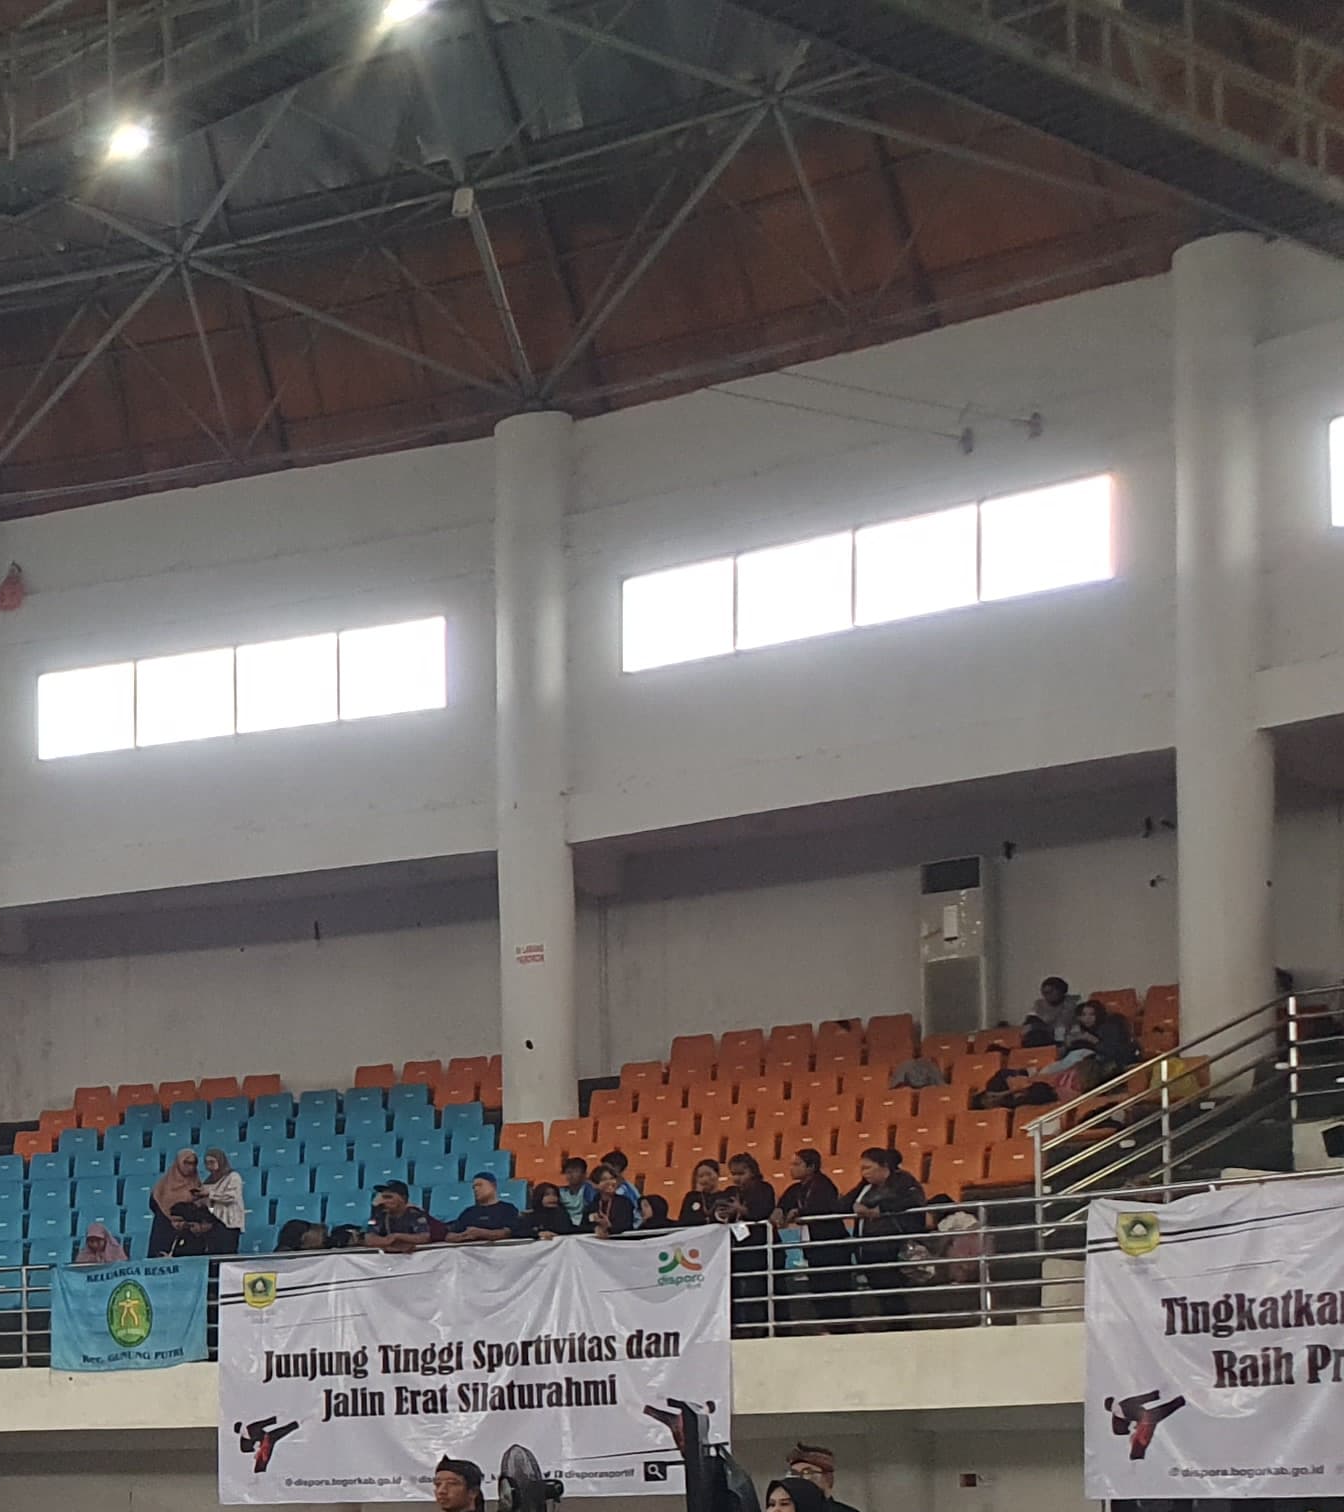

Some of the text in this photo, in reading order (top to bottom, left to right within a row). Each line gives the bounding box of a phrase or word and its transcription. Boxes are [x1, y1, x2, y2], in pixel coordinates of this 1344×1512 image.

[86, 1265, 180, 1283] KELUARGA BESAR
[1161, 1288, 1344, 1338] Tingkatka
[107, 1351, 151, 1363] GUNUNG
[154, 1348, 185, 1360] PUTRI
[263, 1329, 680, 1383] Junjung Tinggi Sportivitas dan
[1212, 1347, 1295, 1388] Raih
[322, 1374, 618, 1422] Jalin Erat Silaturahmi
